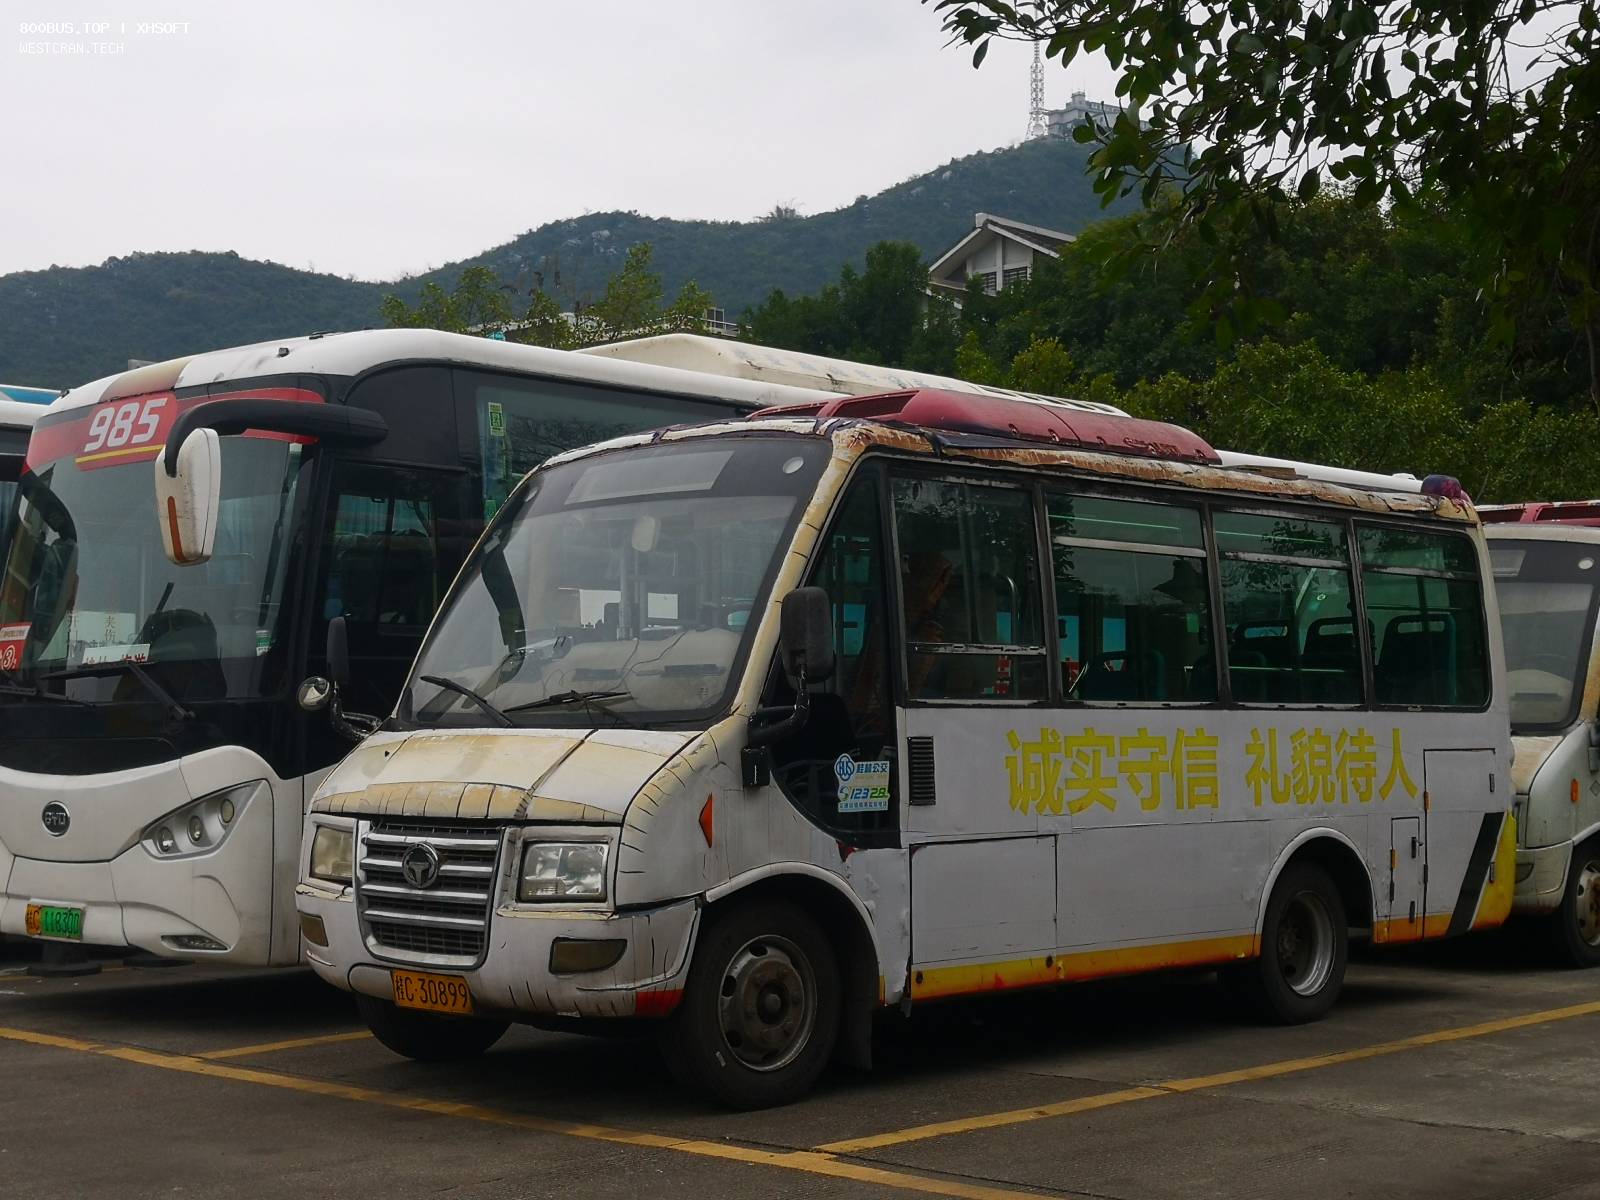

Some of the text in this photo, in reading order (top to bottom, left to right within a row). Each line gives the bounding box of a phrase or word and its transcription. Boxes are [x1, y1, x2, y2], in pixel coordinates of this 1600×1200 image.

[84, 398, 167, 452] 985
[1004, 727, 1418, 815] 诚实守信 礼貌待人
